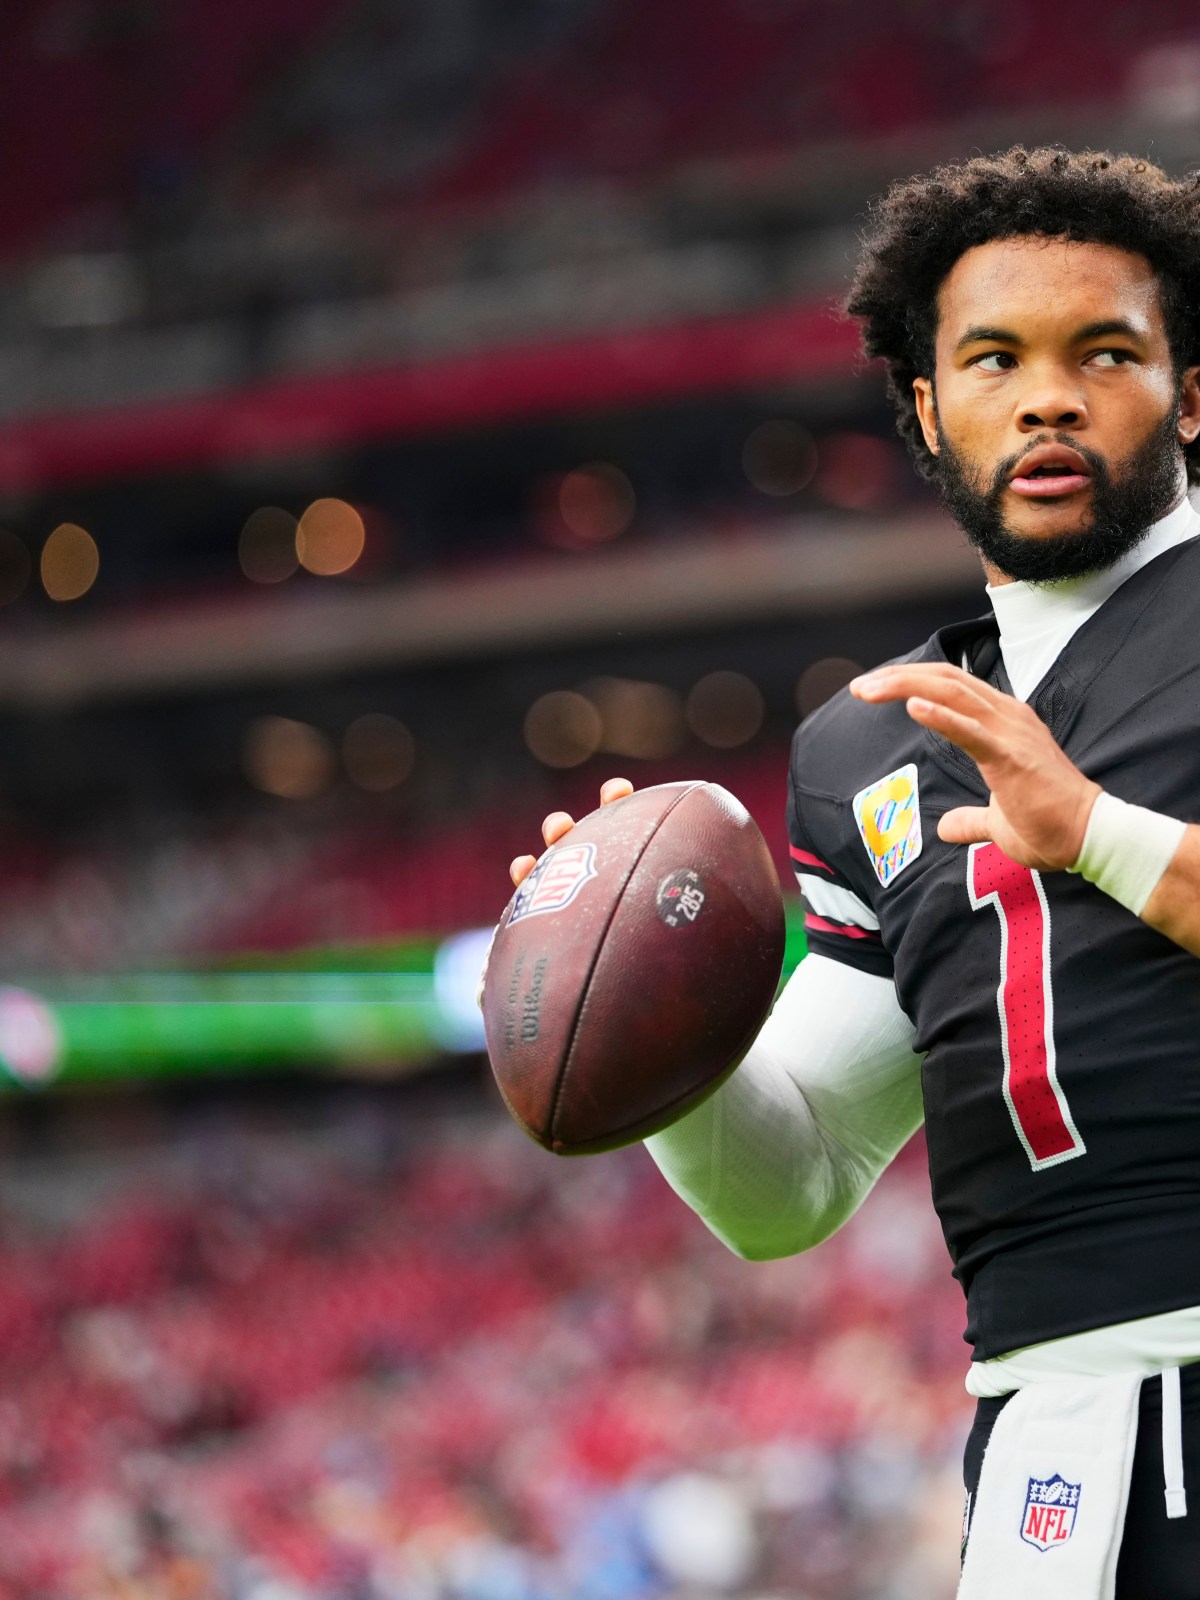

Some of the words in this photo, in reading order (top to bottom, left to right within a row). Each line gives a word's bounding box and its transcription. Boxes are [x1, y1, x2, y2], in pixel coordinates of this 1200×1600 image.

[532, 850, 586, 907] NFL
[675, 884, 705, 922] 285
[520, 956, 548, 1042] Wilson
[967, 842, 1087, 1172] 1
[1025, 1505, 1069, 1543] NFL
